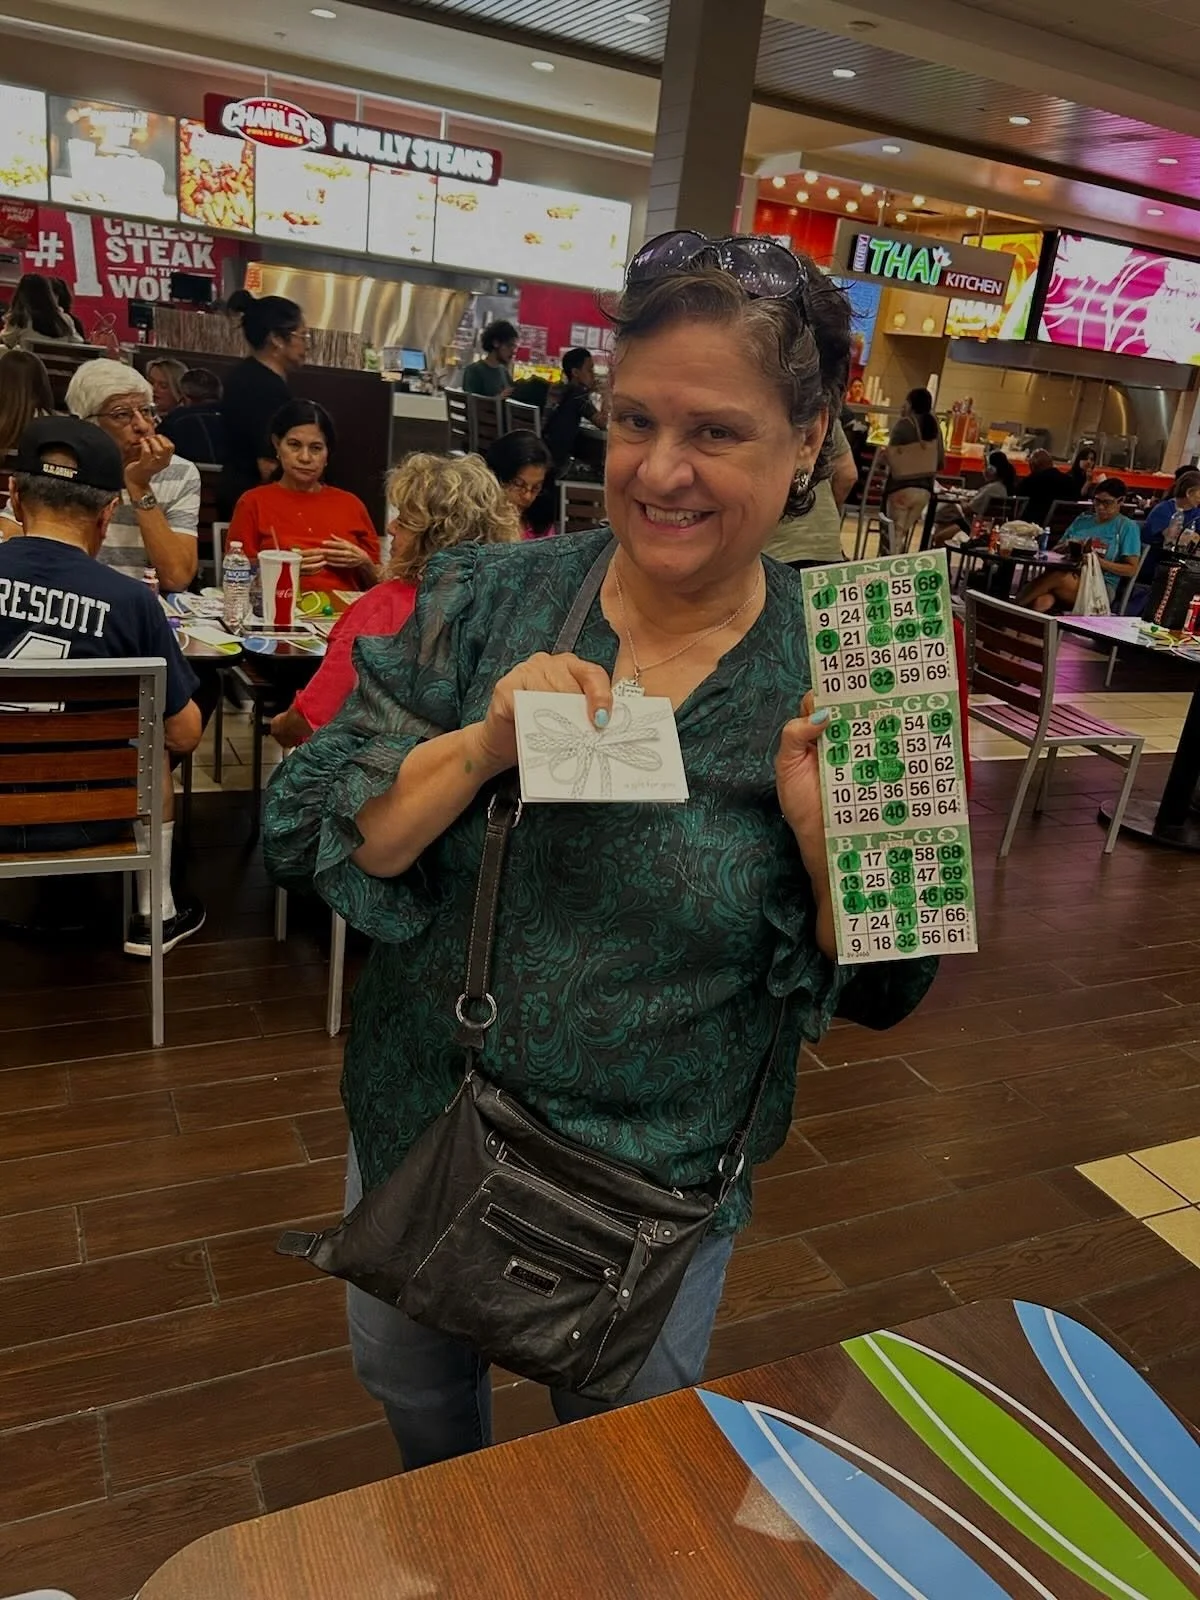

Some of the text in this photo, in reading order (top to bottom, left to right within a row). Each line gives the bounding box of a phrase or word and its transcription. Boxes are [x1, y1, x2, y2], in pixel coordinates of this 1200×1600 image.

[222, 103, 327, 149] CHARLEYS
[333, 122, 494, 181] PHILLY STEAKS
[105, 236, 216, 269] STEAK
[145, 266, 157, 276] IN
[945, 272, 1003, 296] KITCHEN
[810, 555, 937, 588] BINGO
[814, 591, 830, 606] 11
[840, 587, 858, 601] 16
[865, 583, 883, 598] 31
[892, 579, 911, 594] 55
[918, 576, 938, 591] 68
[820, 599, 940, 627] 9 24 41 54 71
[823, 635, 832, 648] 8
[843, 631, 860, 646] 21
[896, 624, 916, 638] 49
[922, 620, 942, 635] 67
[821, 643, 944, 671] 14 25 36 46 70
[823, 665, 946, 692] 10 30 32 59 69
[828, 693, 949, 720] BINGO
[831, 713, 950, 738] 8 23 41 54 65
[832, 735, 951, 760] 11 21 33 53 74
[835, 768, 844, 781] 5
[857, 765, 874, 779] 18
[909, 760, 928, 774] 60
[935, 757, 954, 772] 62
[833, 778, 956, 803] 10 25 36 56 67
[835, 799, 957, 824] 13 26 40 59 64
[835, 826, 959, 852] BINGO
[843, 845, 961, 868] 1 17 34 58 68
[841, 865, 962, 889] 13 25 38 47 69
[847, 896, 856, 910] 4
[869, 894, 887, 908] 16
[919, 888, 938, 903] 46
[944, 887, 964, 901] 65
[849, 908, 965, 931] 7 24 41 57 66
[852, 929, 964, 952] 9 18 32 56 61
